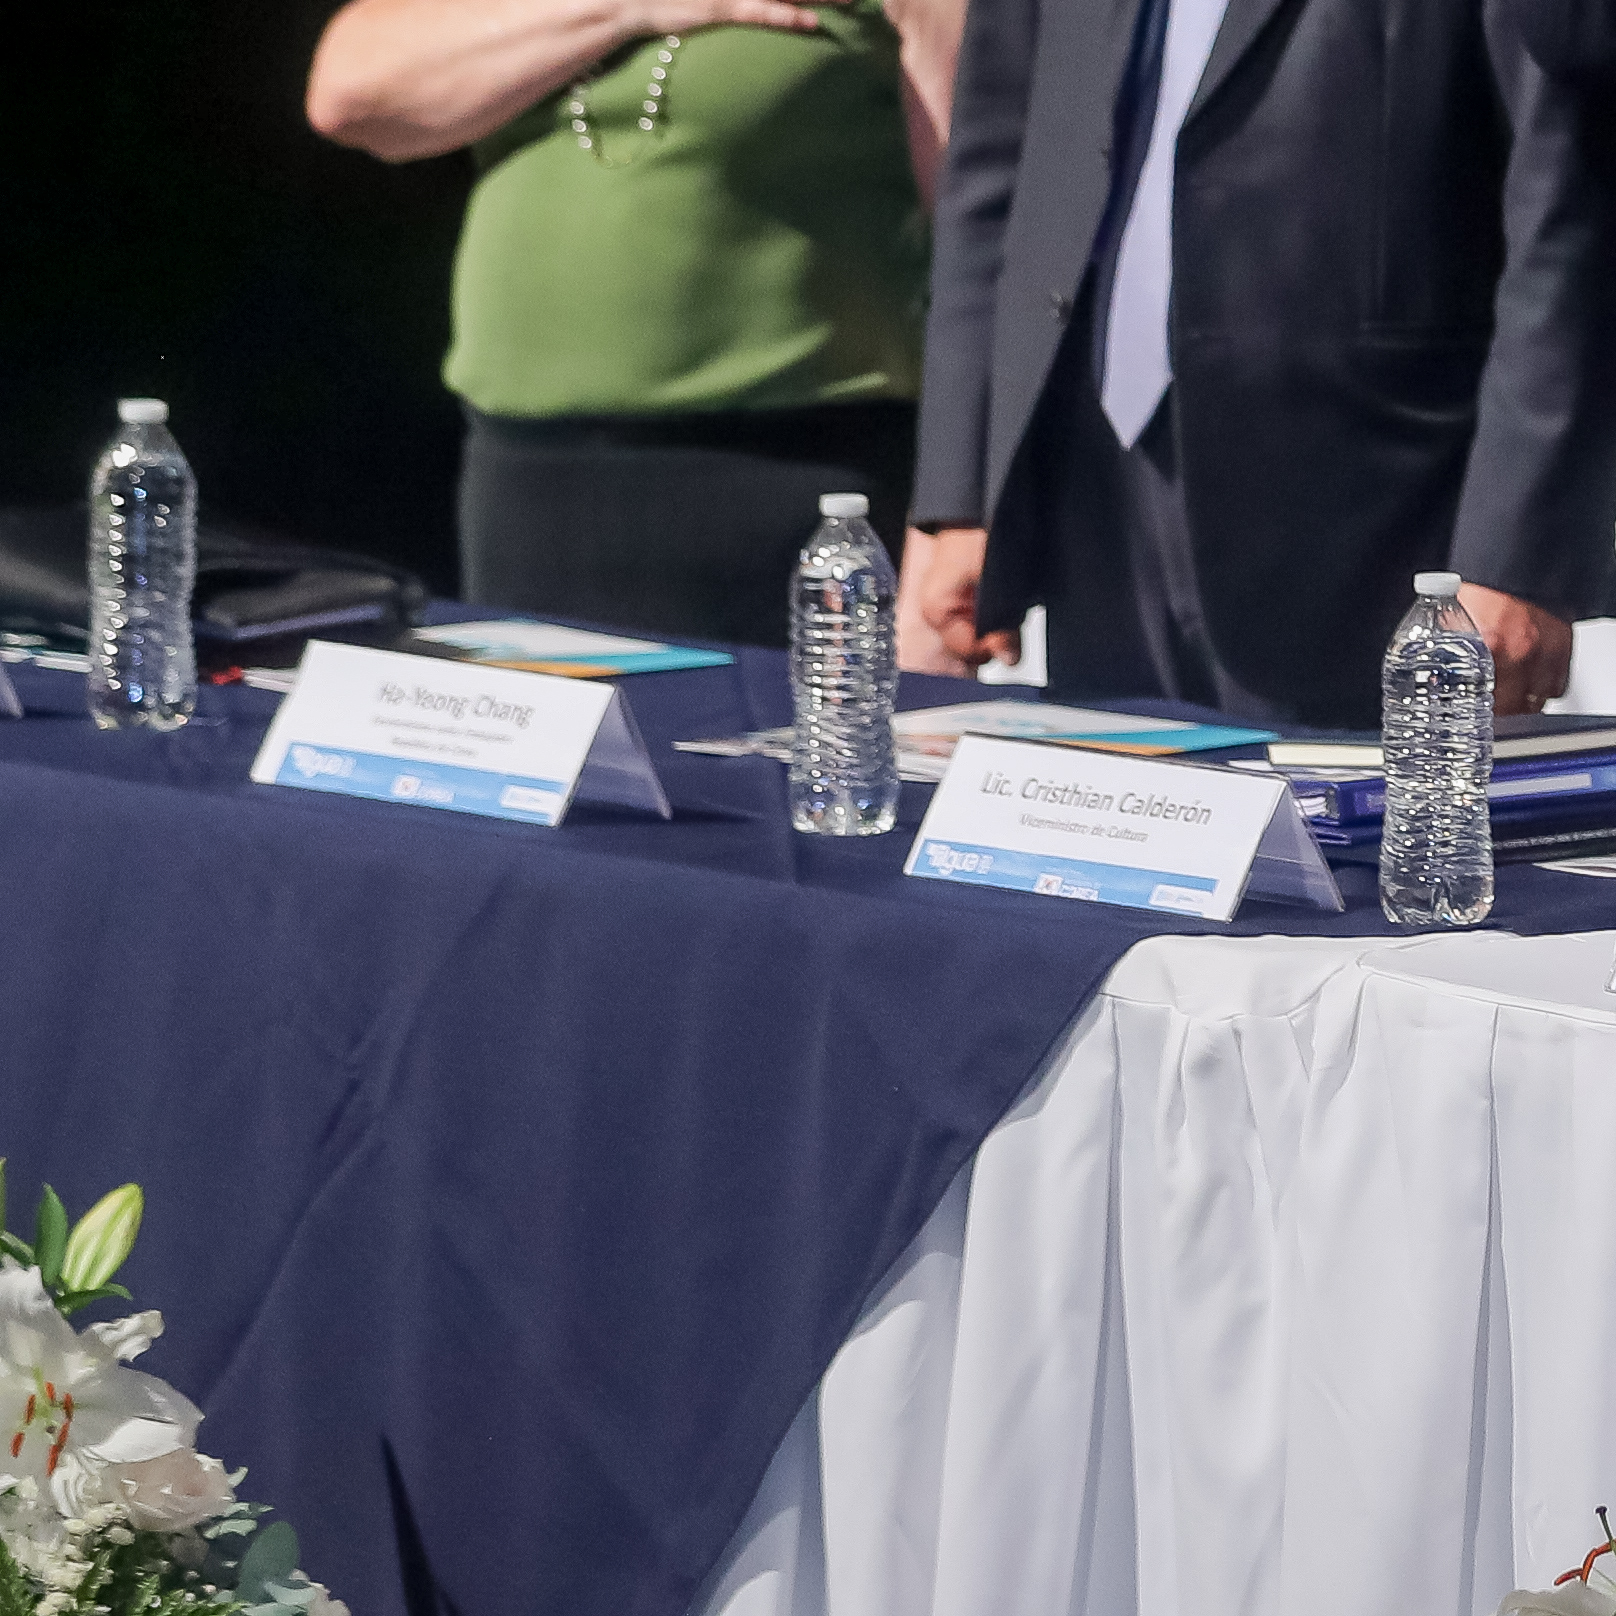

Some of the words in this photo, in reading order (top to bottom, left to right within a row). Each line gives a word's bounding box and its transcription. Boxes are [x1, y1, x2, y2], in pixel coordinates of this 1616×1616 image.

[981, 771, 1012, 797] Lic.
[1020, 777, 1114, 812] Cristhian
[1118, 791, 1212, 825] Calderón
